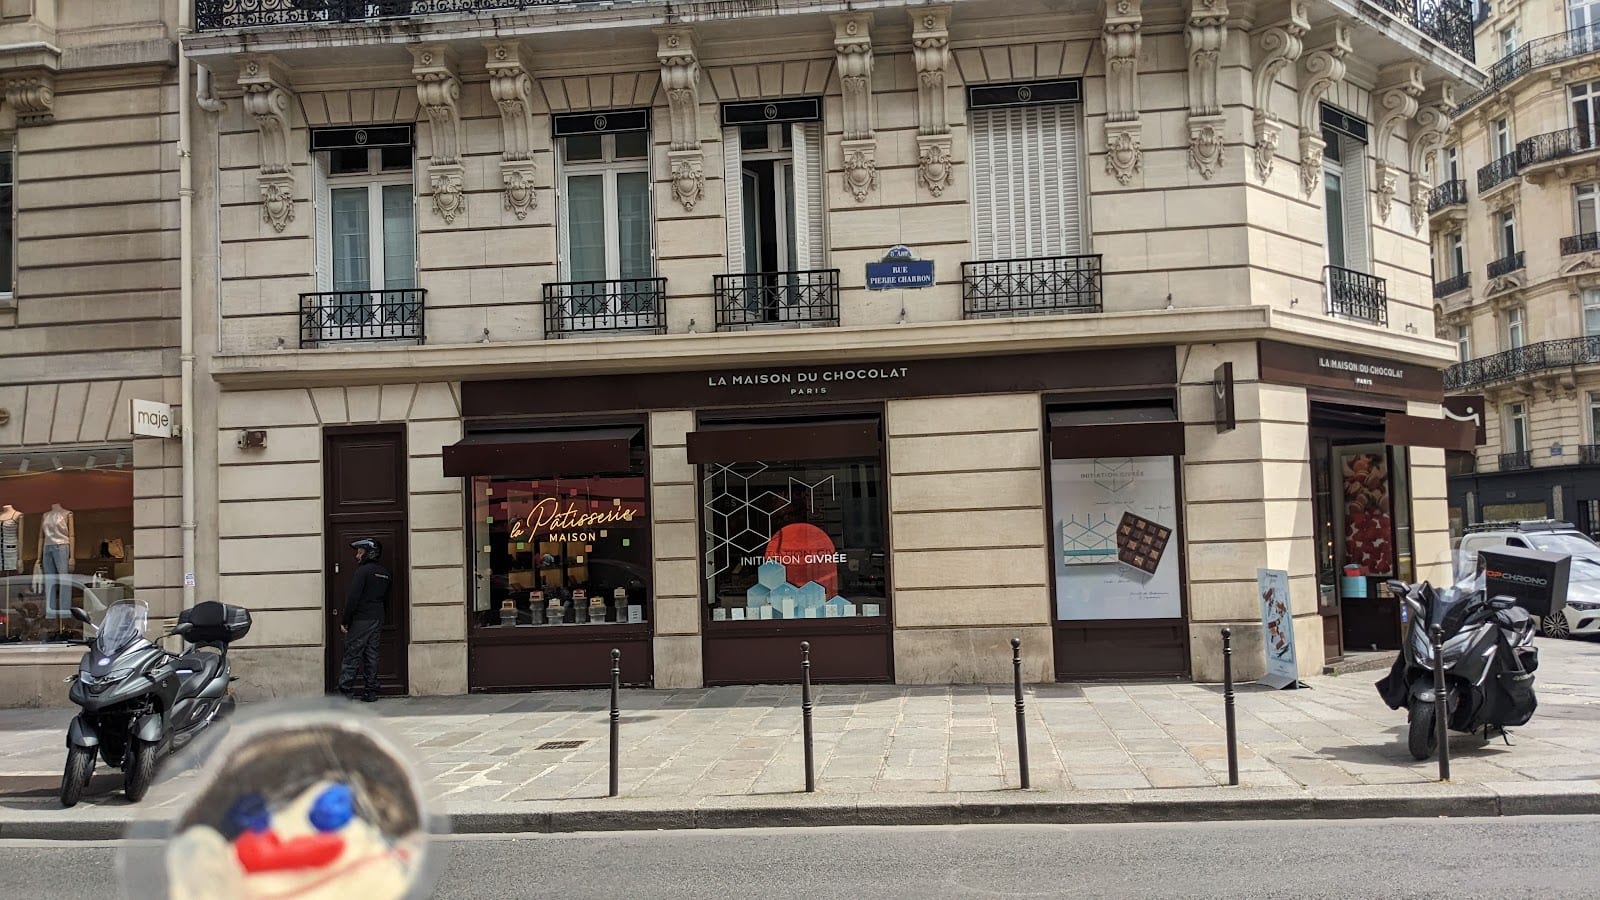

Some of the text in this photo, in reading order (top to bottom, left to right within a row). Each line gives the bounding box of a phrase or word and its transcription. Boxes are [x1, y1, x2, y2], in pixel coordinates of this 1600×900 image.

[892, 266, 908, 274] RUE
[870, 274, 931, 284] PIERRE CHARRON
[1319, 357, 1404, 379] LA MAISON DU CHOCOLAT
[708, 367, 908, 387] LA MAISON DU CHOCOLAT
[790, 387, 827, 395] PARIS
[137, 410, 169, 429] maje
[510, 497, 637, 543] la Pâtisserie
[549, 531, 596, 543] MAISON
[740, 551, 847, 567] INITIATION GIVRÉE
